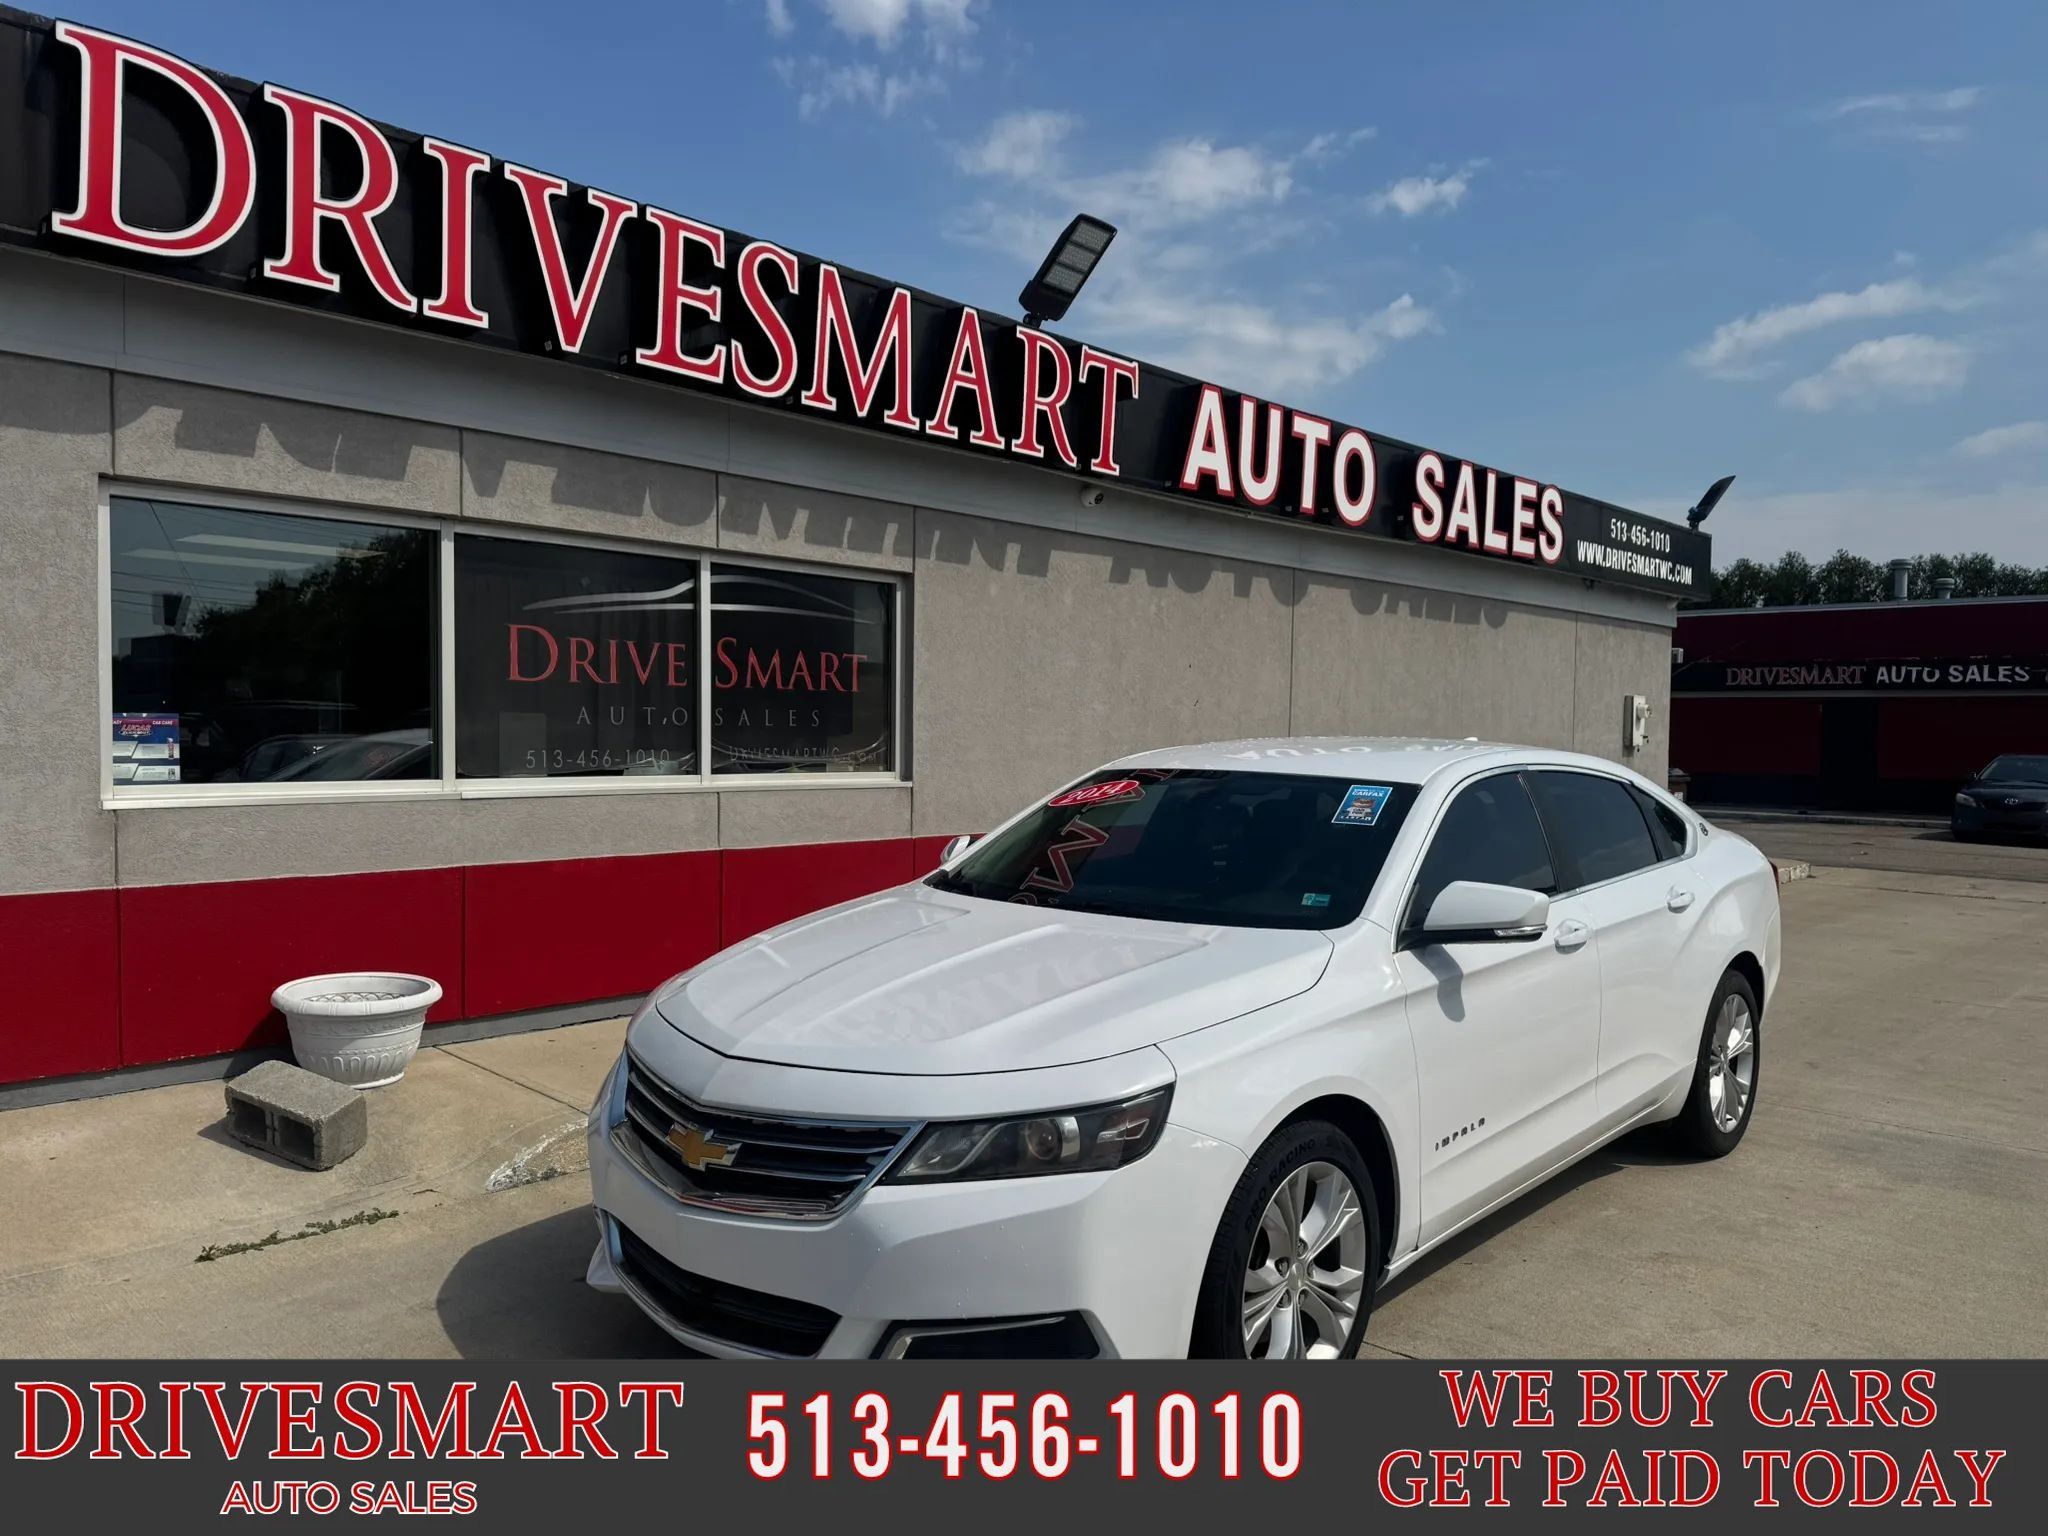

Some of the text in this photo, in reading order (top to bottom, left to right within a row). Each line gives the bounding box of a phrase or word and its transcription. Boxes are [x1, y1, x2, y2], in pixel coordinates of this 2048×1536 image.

[51, 17, 1565, 565] DRIVESMART AUTO SALES
[1611, 518, 1671, 554] 513-456-1010
[1577, 539, 1693, 586] WWW.DRIVESMARTWC.COM
[505, 622, 868, 693] DRIVE SMART
[1726, 664, 1866, 686] DRIVESMART
[1876, 665, 1940, 684] AUTO
[1948, 664, 2031, 684] SALES
[577, 706, 821, 727] AUTO SALES
[1059, 780, 1128, 805] 2014
[1434, 1117, 1485, 1152] IMPALA
[1268, 1138, 1316, 1184] RACING
